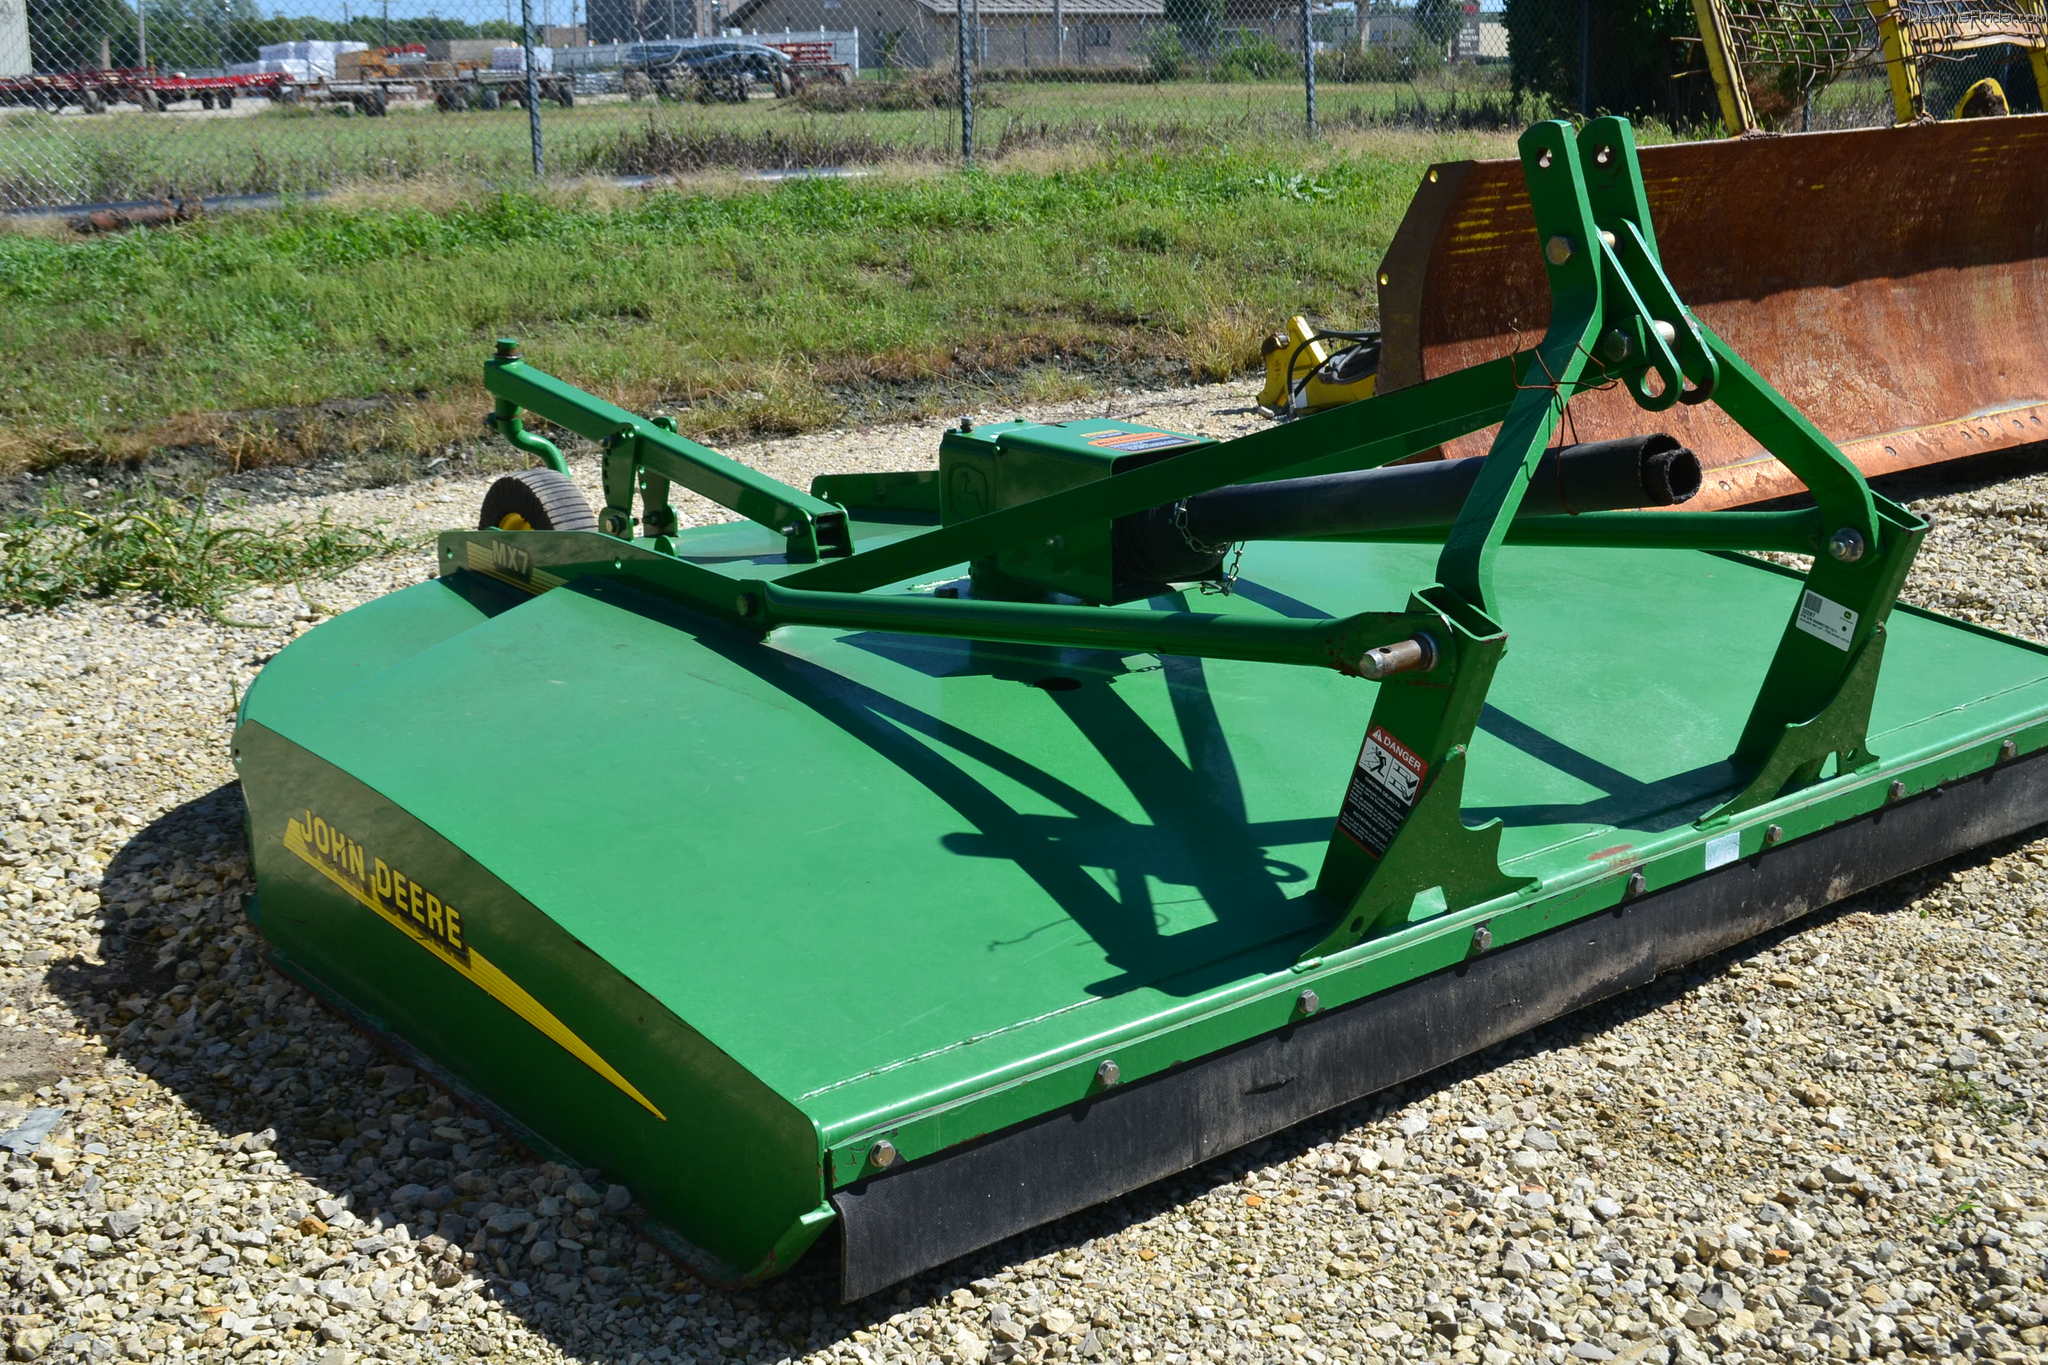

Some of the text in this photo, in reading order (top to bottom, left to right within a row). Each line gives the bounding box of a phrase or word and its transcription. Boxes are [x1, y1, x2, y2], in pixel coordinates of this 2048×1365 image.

[492, 540, 529, 575] MX7
[1382, 736, 1422, 772] DANGER
[300, 808, 463, 949] JOHN DEERE
